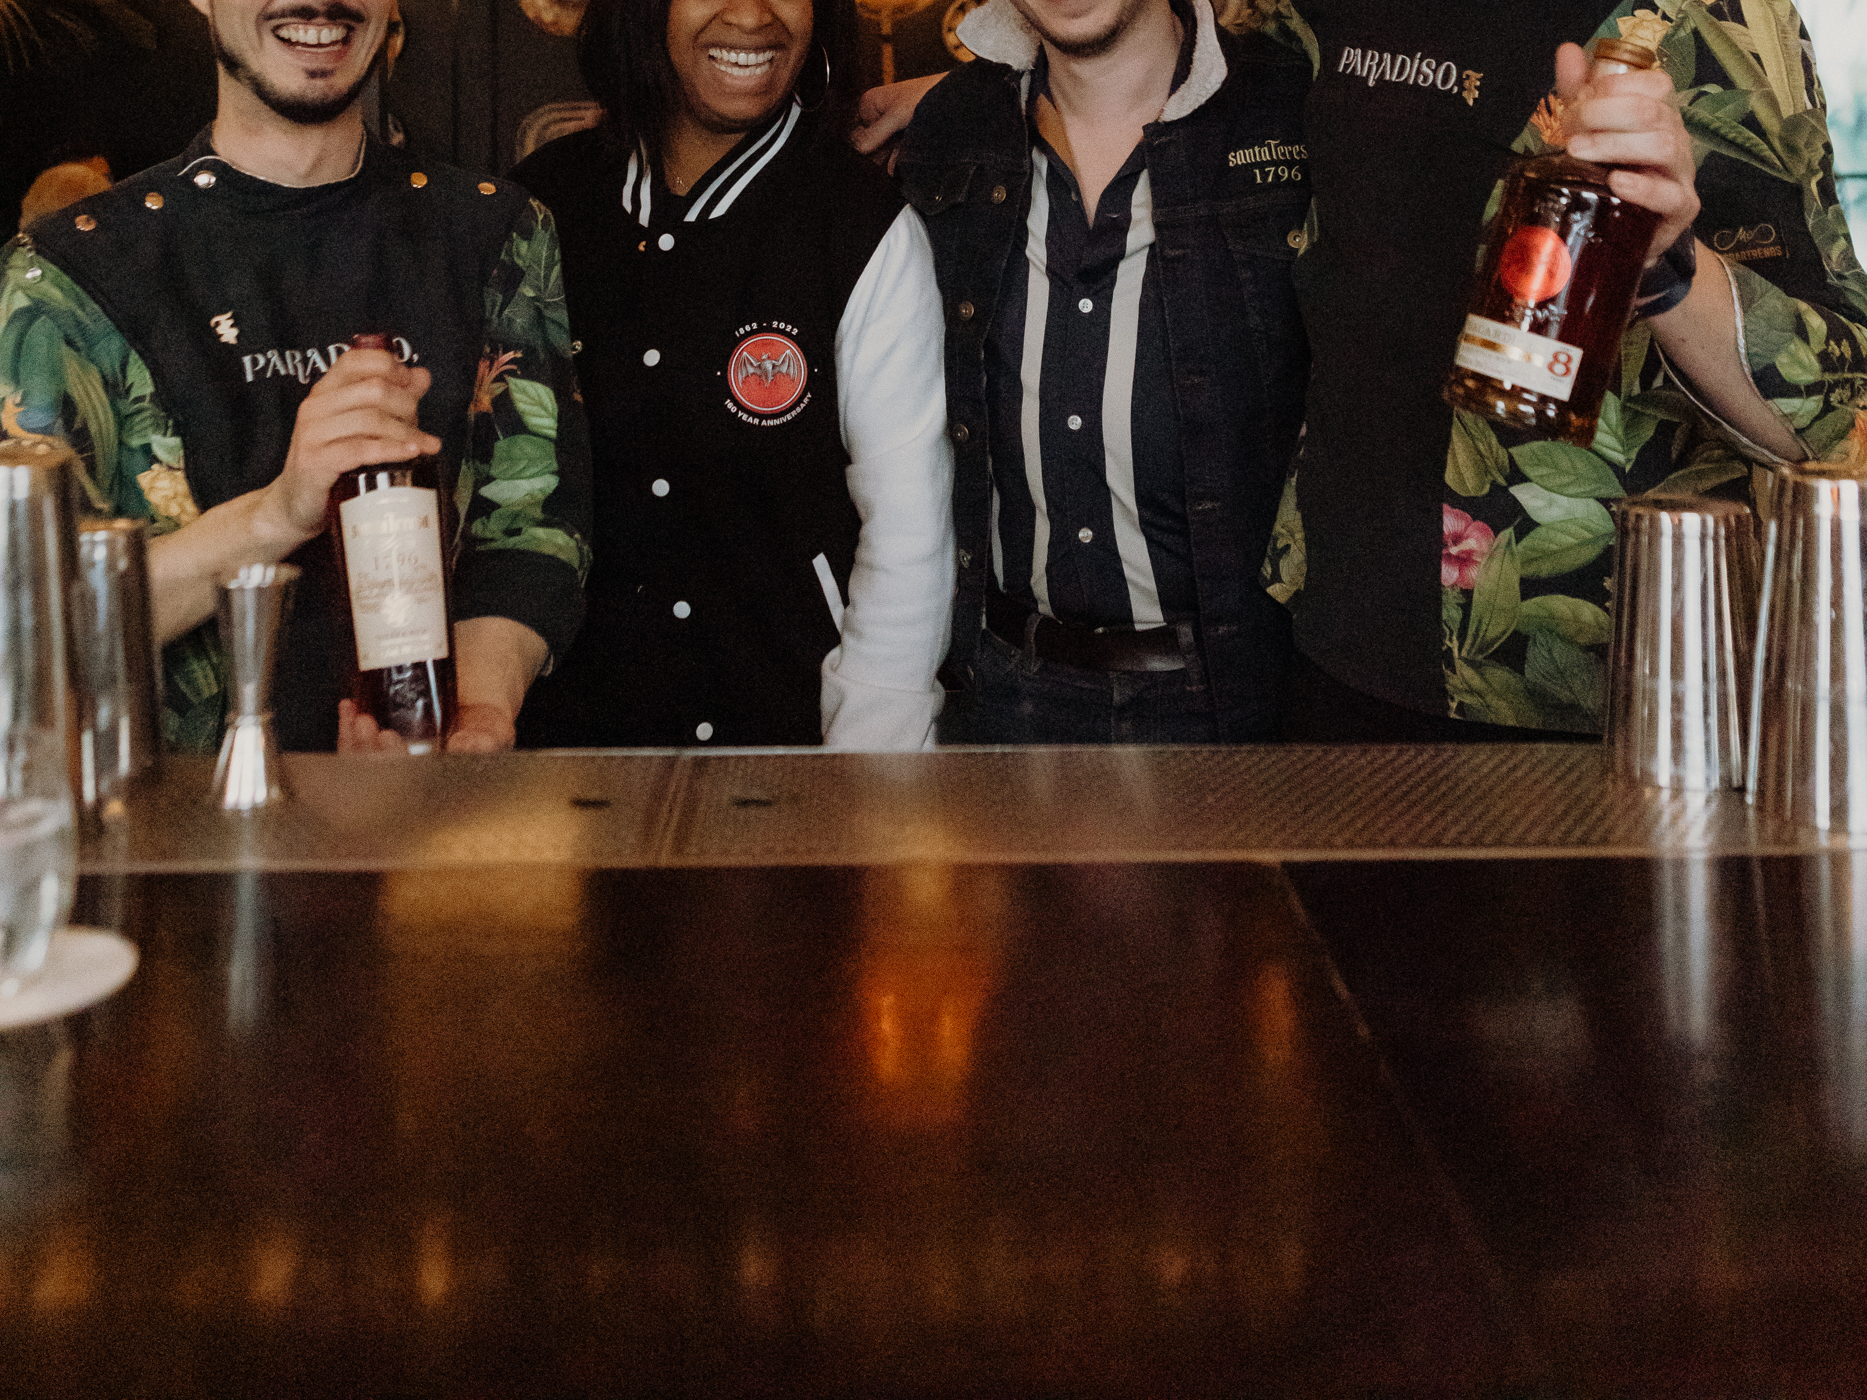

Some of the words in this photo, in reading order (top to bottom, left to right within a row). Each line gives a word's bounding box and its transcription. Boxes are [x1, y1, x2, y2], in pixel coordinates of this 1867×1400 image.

[1253, 165, 1302, 184] 1796
[735, 322, 758, 338] 1862
[772, 321, 798, 336] 2022
[1547, 351, 1573, 377] 8
[724, 399, 738, 413] 160
[737, 410, 760, 425] YEAR
[760, 392, 812, 426] ANNIVERSARY
